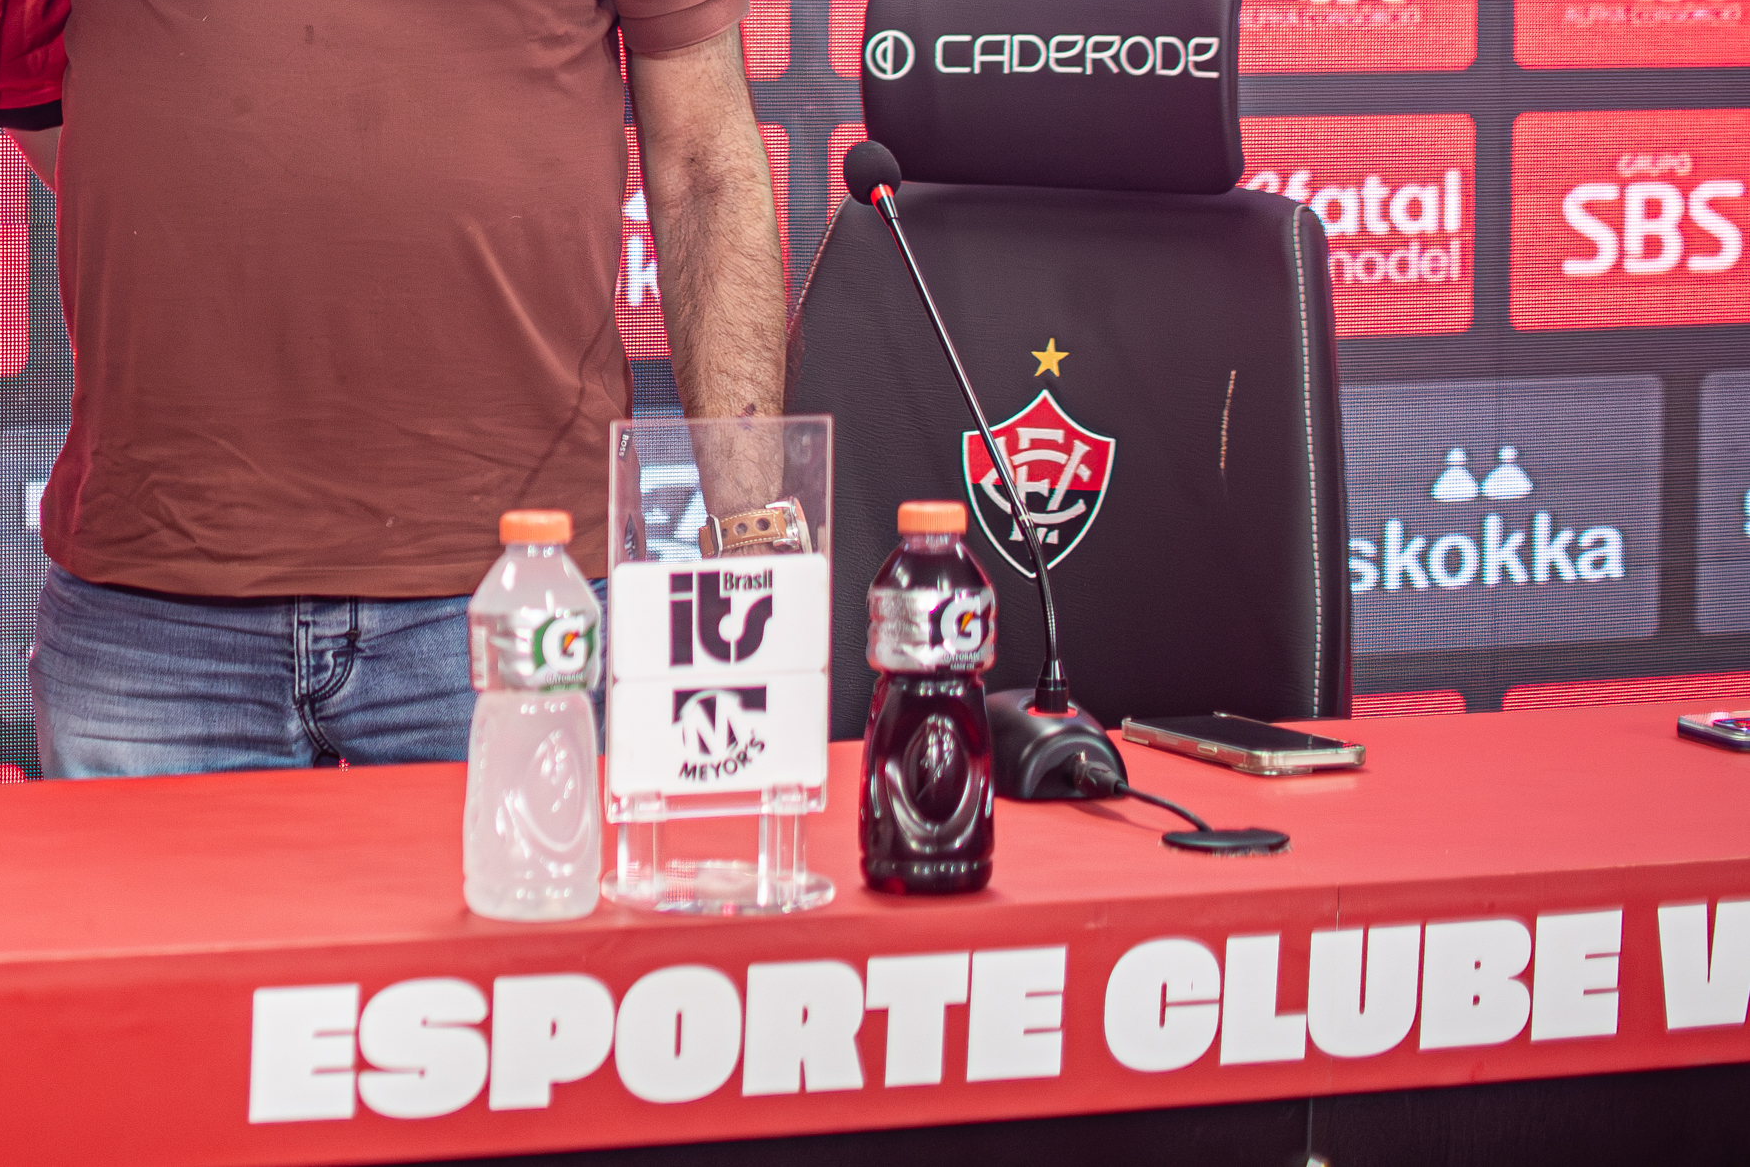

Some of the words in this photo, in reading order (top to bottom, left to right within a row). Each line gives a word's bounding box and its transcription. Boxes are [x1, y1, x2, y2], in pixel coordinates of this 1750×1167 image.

[1561, 180, 1745, 277] SBS
[618, 433, 630, 457] BOSS
[721, 569, 774, 591] Brasil
[1347, 510, 1626, 594] skokka
[250, 944, 1068, 1124] ESPORTE
[1104, 908, 1624, 1074] CLUBE
